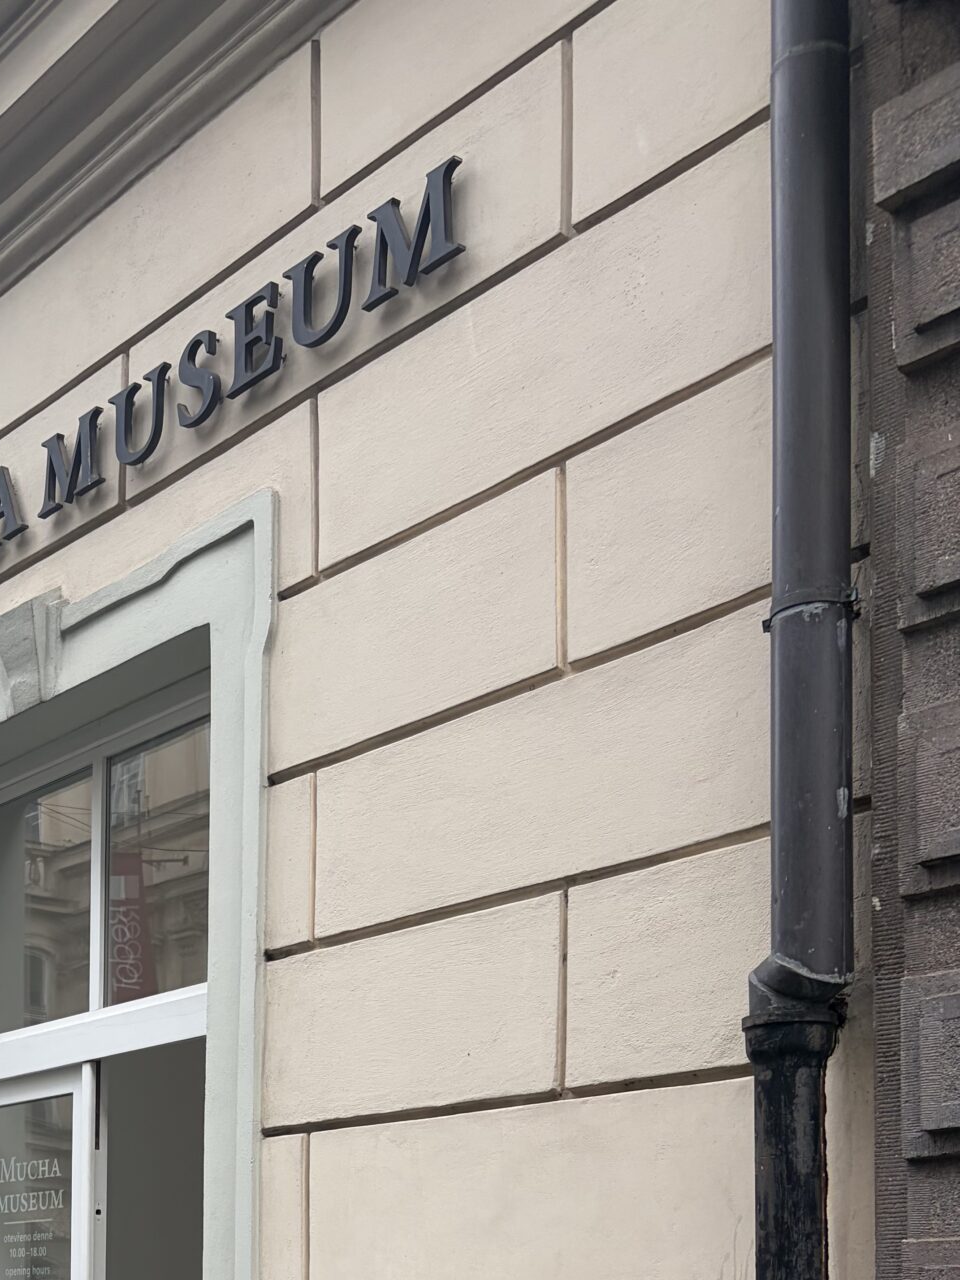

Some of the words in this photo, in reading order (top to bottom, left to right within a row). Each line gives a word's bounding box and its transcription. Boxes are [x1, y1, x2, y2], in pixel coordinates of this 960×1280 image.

[37, 155, 467, 520] MUSEUM
[5, 1266, 31, 1278] opening
[31, 1265, 51, 1276] hours
